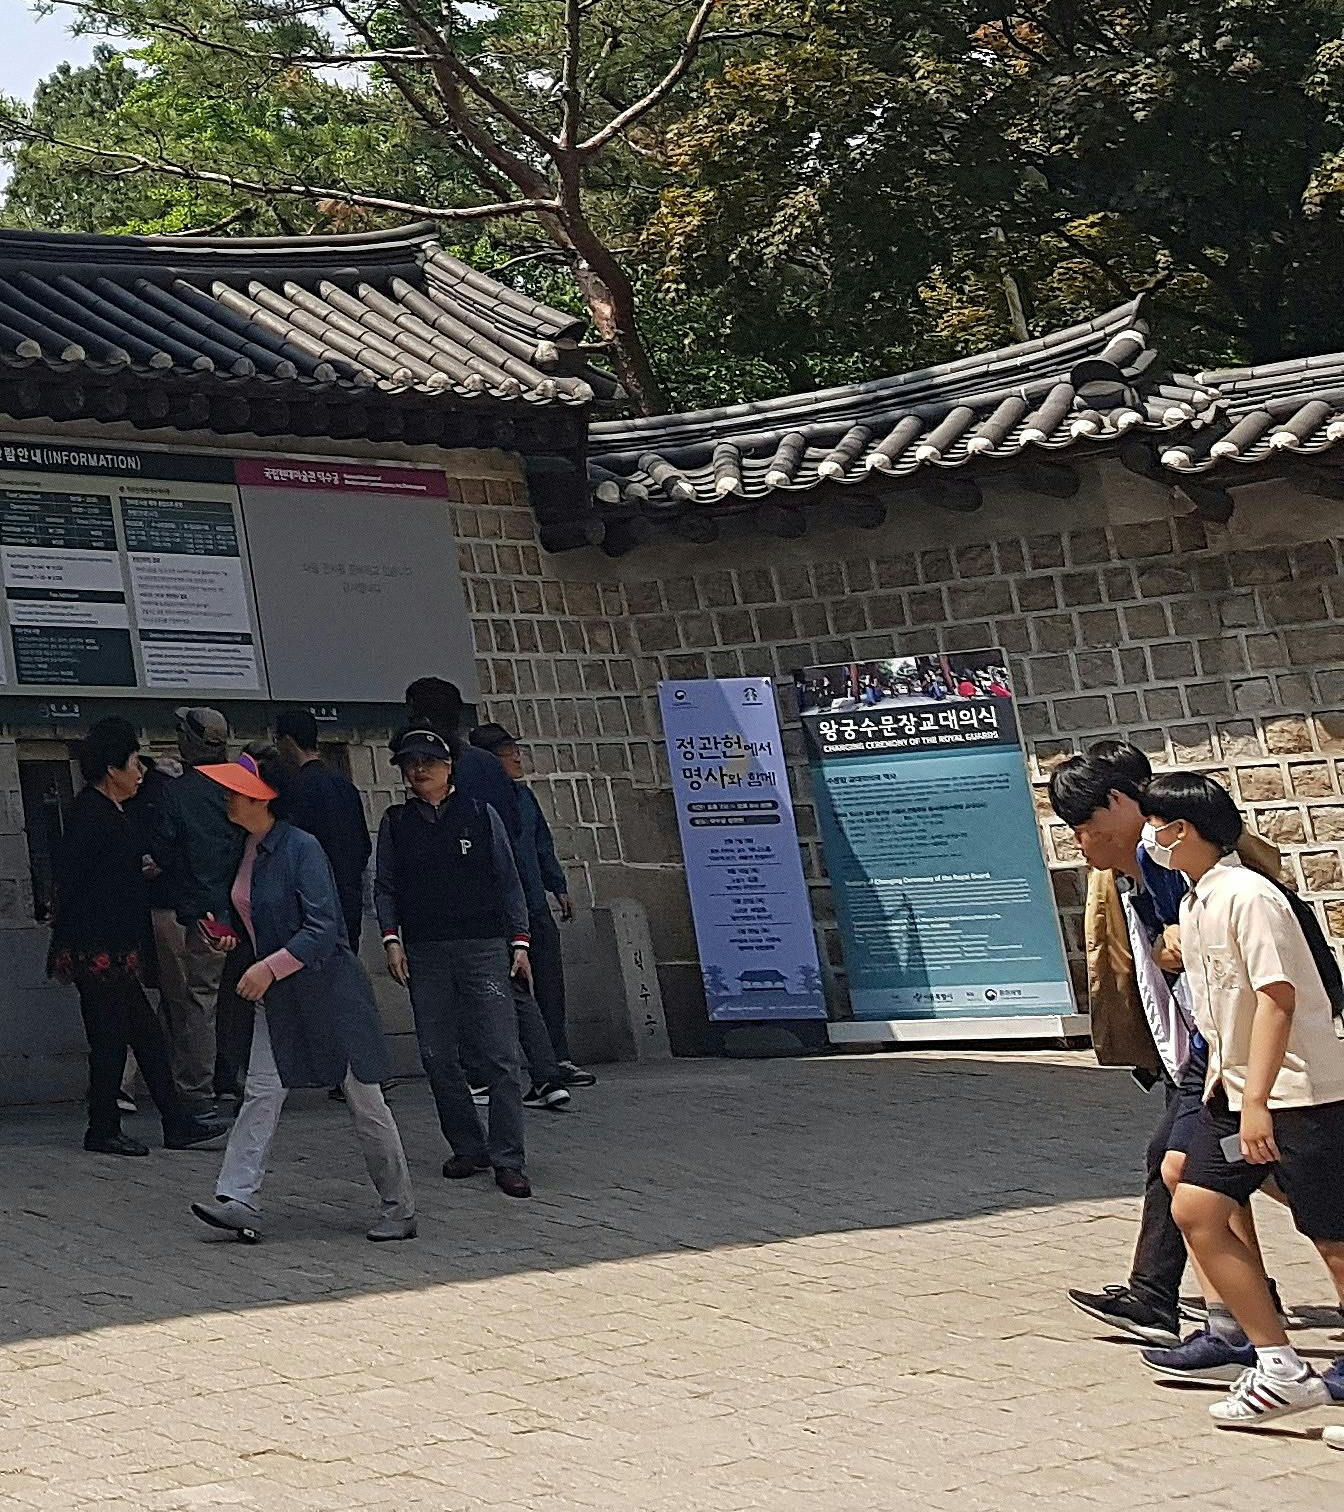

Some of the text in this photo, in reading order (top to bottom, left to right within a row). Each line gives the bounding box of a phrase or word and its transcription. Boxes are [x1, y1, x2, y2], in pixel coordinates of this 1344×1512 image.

[819, 705, 999, 742] 왕궁수문장교대의식
[675, 734, 772, 761] 정관헌에서
[681, 766, 742, 790] 명사와
